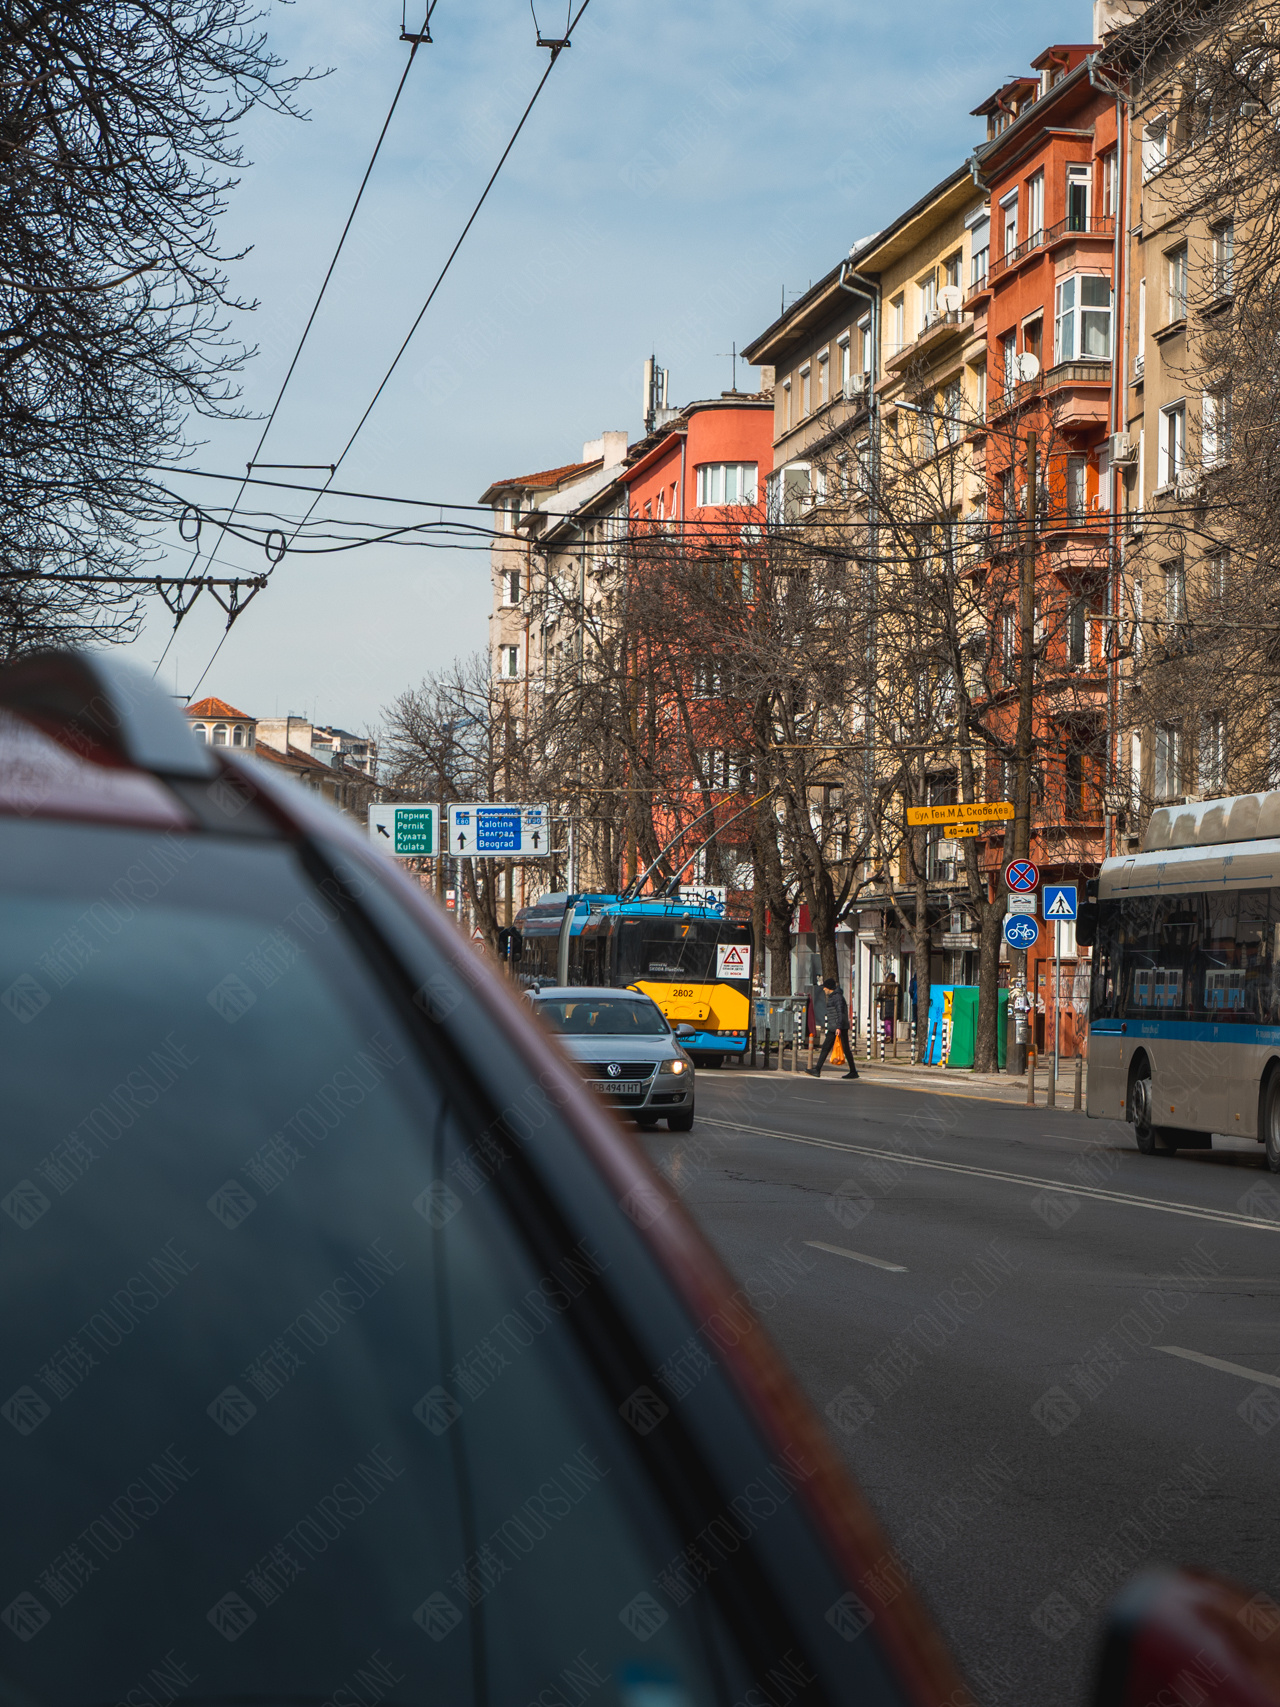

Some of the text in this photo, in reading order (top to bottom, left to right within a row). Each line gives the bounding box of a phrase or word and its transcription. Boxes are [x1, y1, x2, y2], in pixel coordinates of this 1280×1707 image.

[397, 812, 430, 820] Перник
[915, 811, 928, 821] бул
[966, 806, 1009, 816] Скобелев
[397, 822, 424, 830] Pernik
[478, 820, 513, 828] Kalotina
[397, 832, 427, 840] Кулата
[478, 830, 514, 838] Белград
[949, 828, 957, 836] 40
[397, 842, 425, 850] Kulata
[479, 840, 514, 848] Beograd
[681, 925, 690, 938] 7
[673, 989, 694, 998] 2802
[606, 1084, 626, 1092] 4941
[628, 1084, 639, 1092] HT
